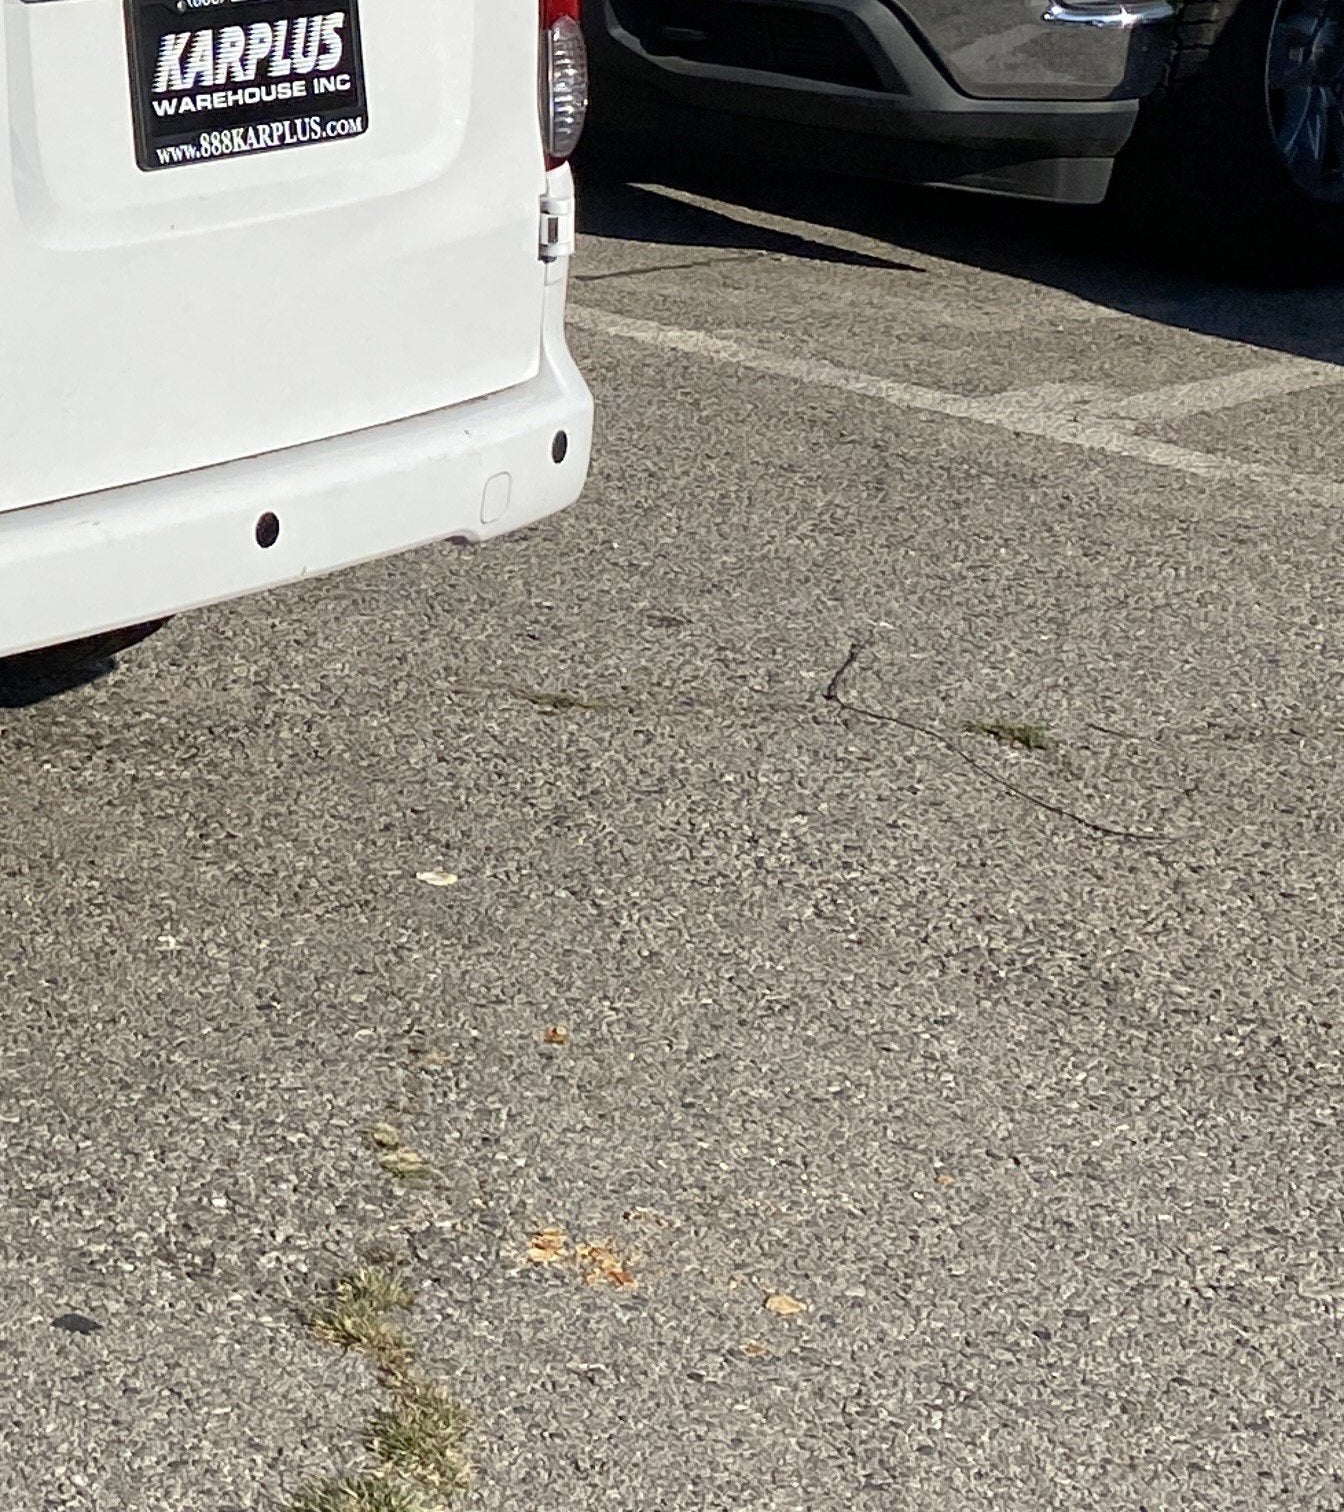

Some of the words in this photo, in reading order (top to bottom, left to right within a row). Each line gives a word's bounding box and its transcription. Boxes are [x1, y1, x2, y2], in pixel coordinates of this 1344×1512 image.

[151, 11, 345, 93] KARPLUS
[152, 80, 307, 117] WAREHOUSE
[313, 73, 351, 95] INC
